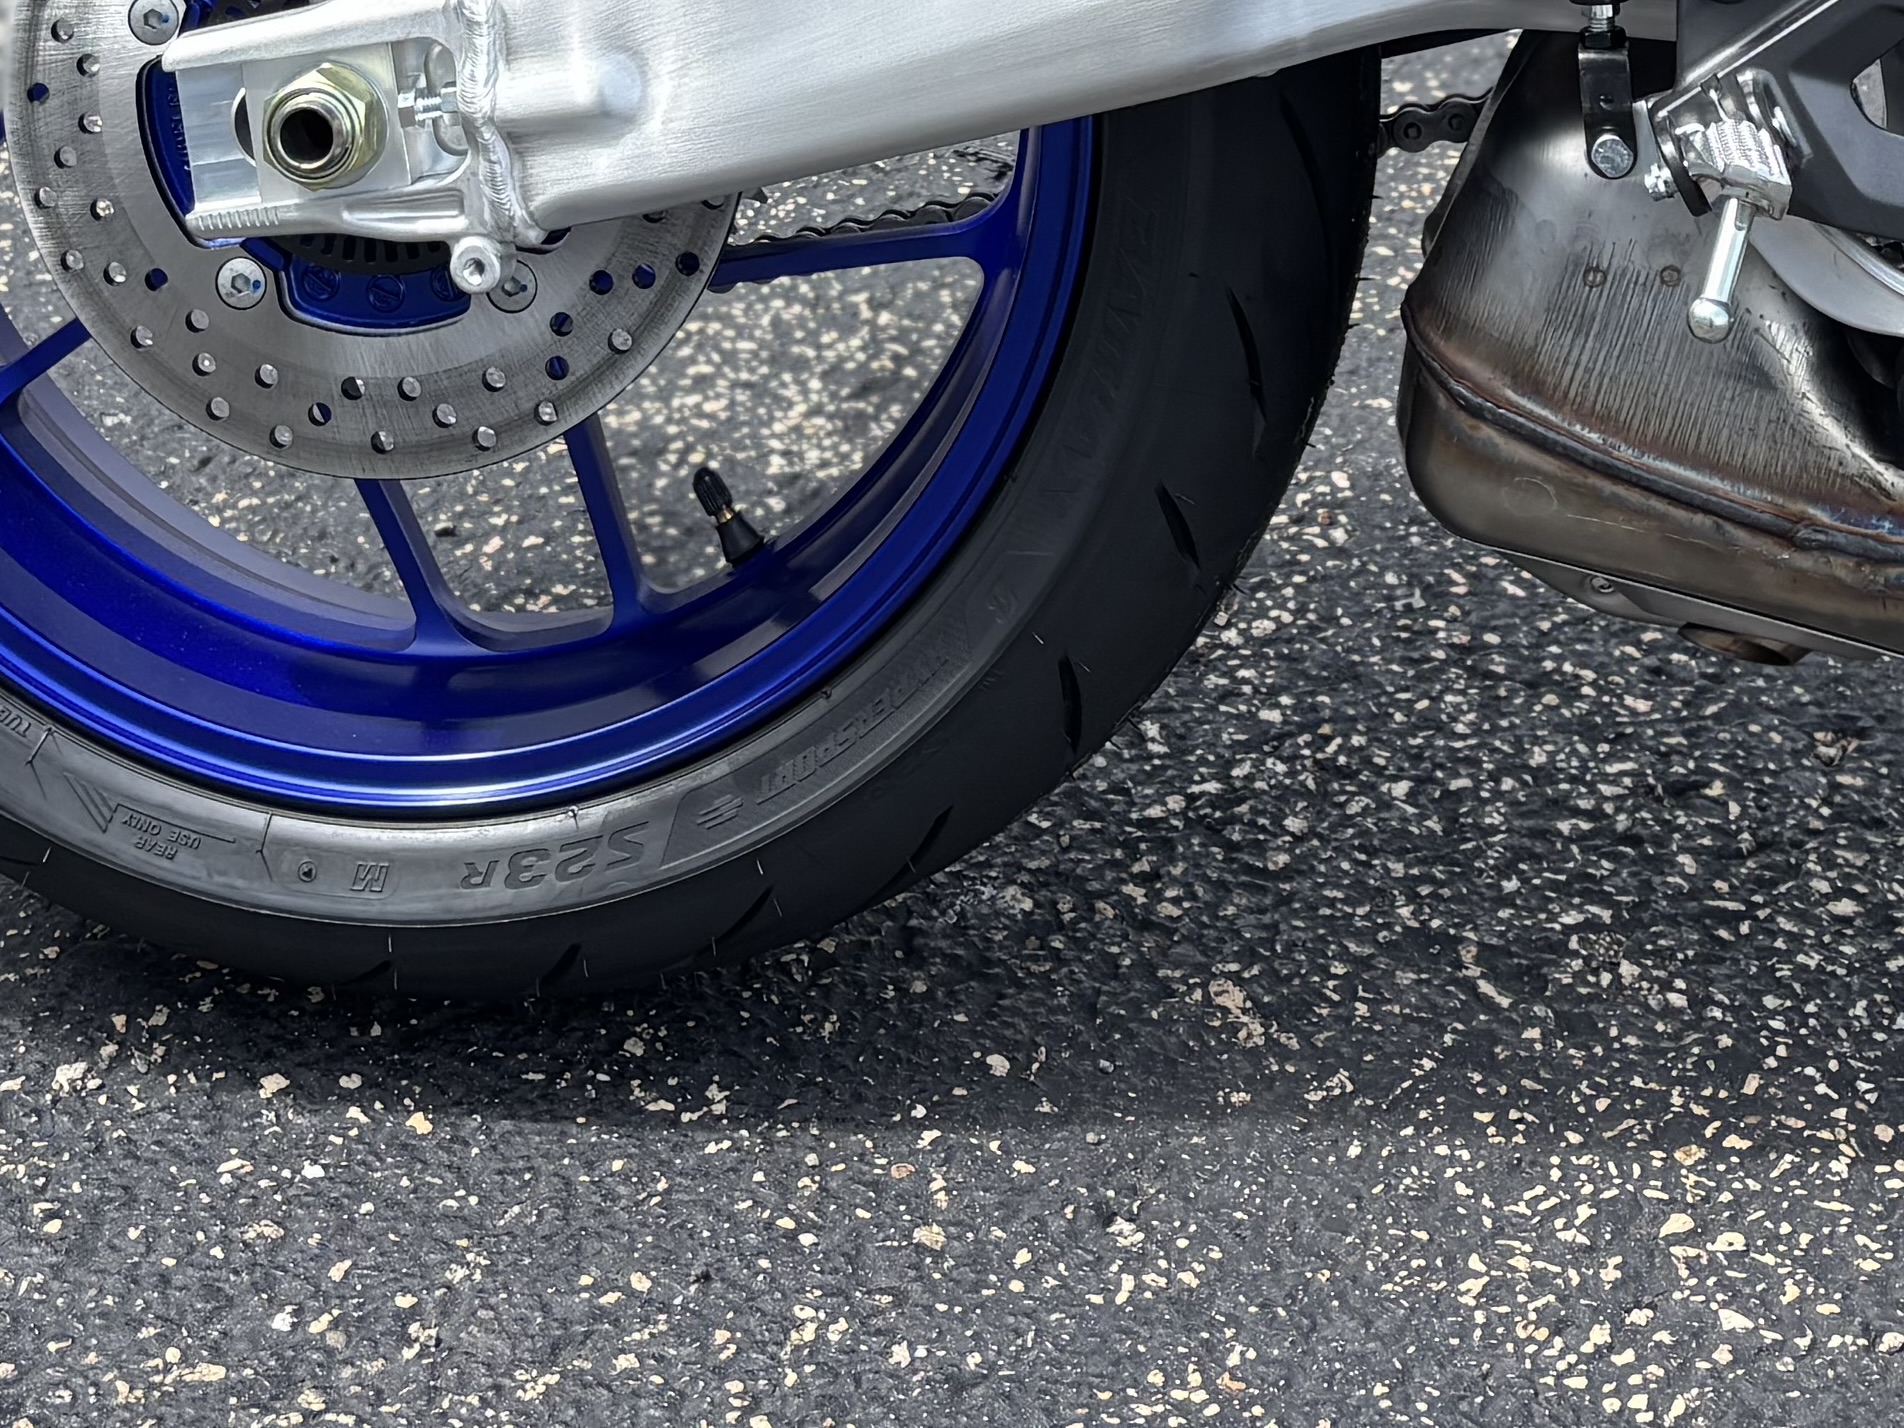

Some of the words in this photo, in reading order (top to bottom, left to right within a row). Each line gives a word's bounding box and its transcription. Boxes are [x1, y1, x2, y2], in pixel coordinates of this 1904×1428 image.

[120, 812, 168, 840] ONLY
[171, 826, 203, 850] USE
[134, 836, 179, 862] REAR
